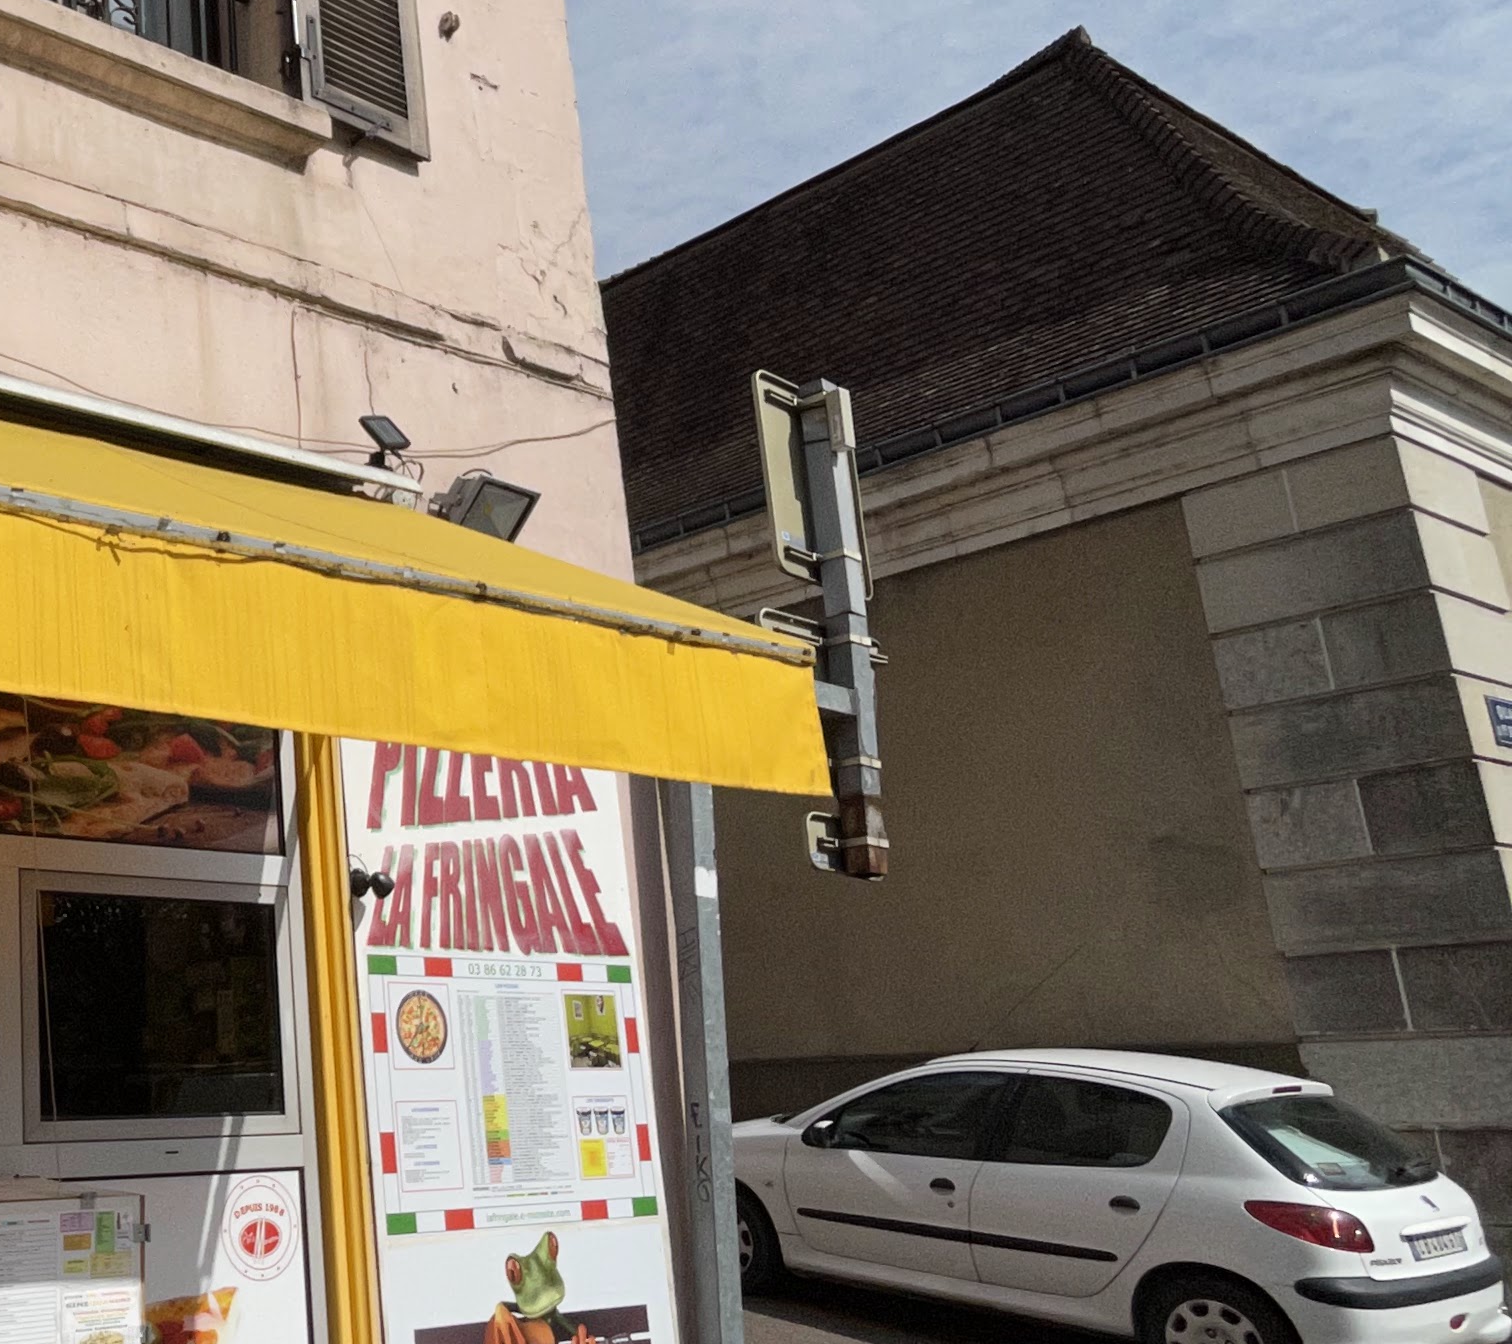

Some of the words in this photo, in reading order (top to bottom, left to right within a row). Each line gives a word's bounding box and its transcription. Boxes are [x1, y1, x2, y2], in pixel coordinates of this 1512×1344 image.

[367, 844, 415, 948] LA
[420, 829, 630, 956] FRINGALE
[468, 963, 481, 975] 03
[484, 964, 497, 975] 86
[499, 964, 511, 976] 62
[514, 965, 527, 977] 28
[530, 966, 542, 977] 73
[233, 1203, 263, 1219] DEPUIS
